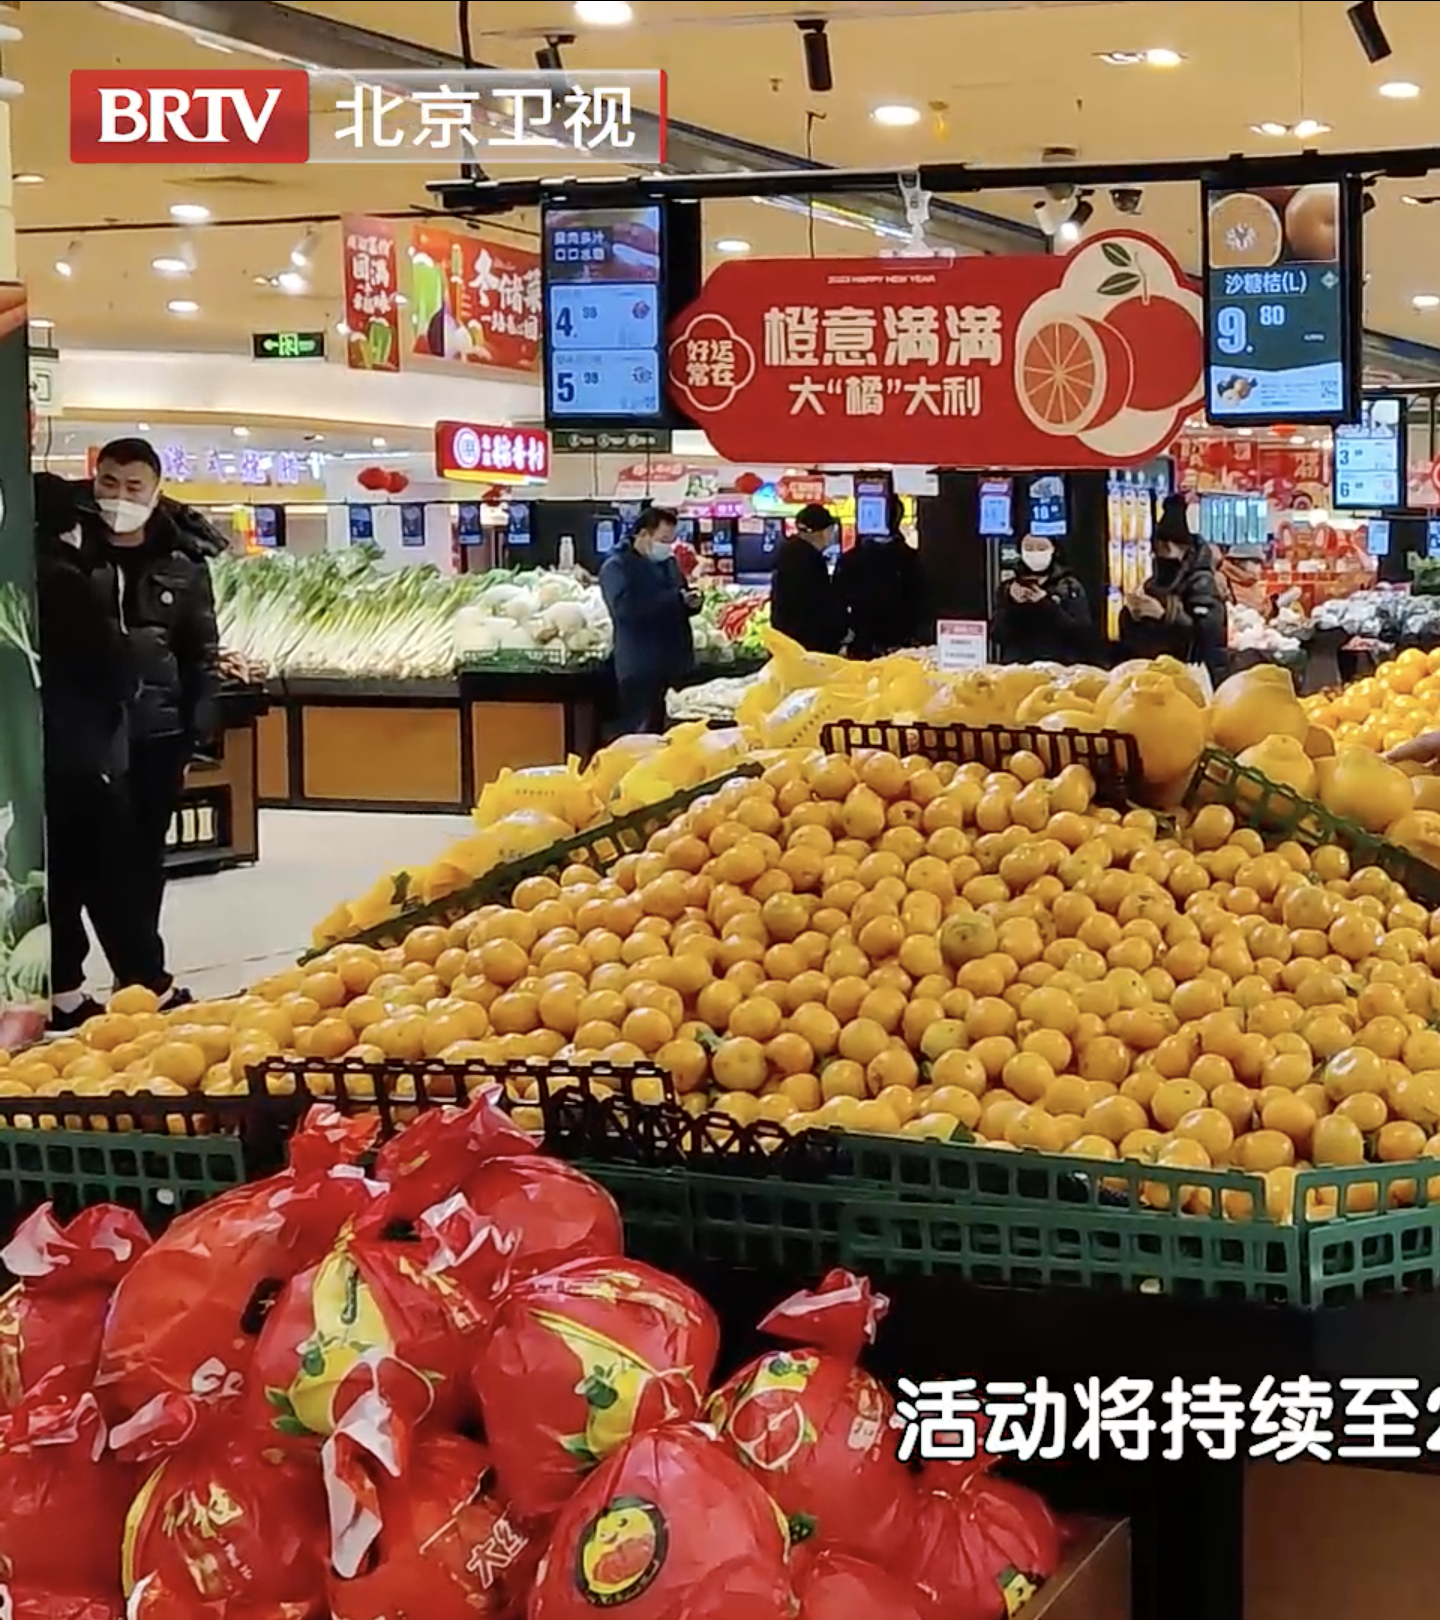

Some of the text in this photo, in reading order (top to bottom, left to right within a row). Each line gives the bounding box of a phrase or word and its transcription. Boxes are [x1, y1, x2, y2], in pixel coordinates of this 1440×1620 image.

[1224, 271, 1308, 294] 沙糖桔(L)
[763, 305, 1002, 367] 橙意满满
[686, 339, 736, 363] 好运
[686, 361, 736, 387] 常在
